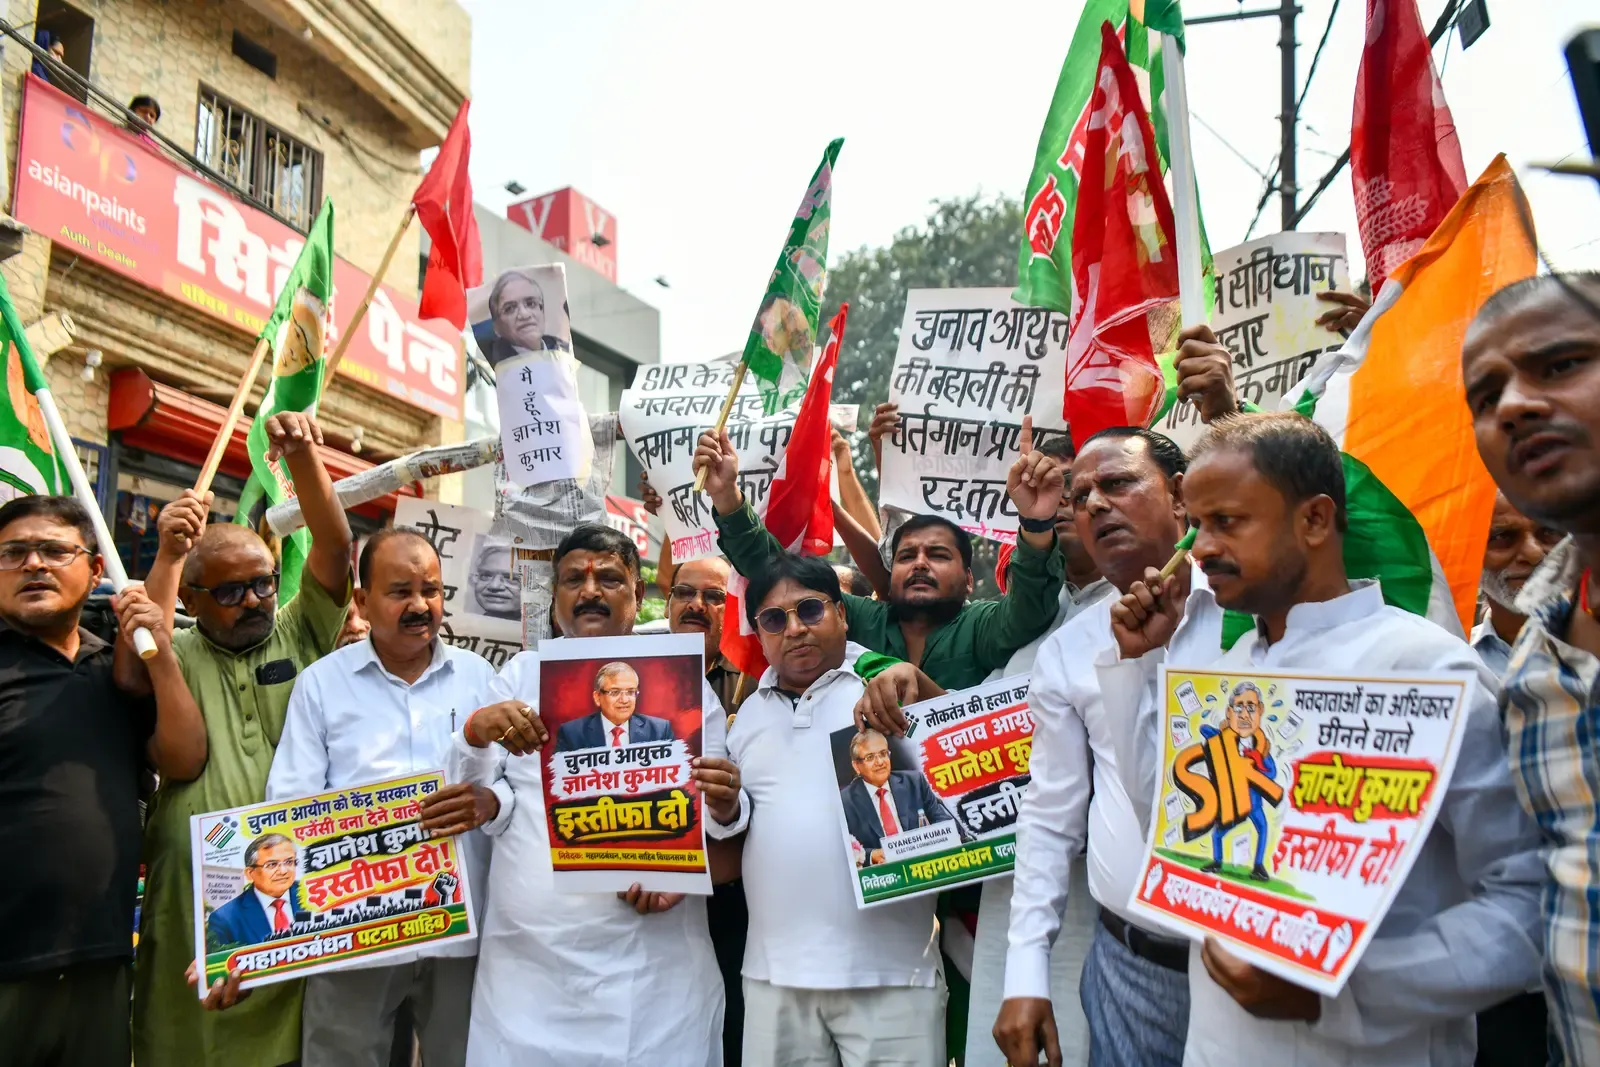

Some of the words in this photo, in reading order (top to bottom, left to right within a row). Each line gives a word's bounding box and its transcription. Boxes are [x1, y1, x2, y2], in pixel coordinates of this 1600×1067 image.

[28, 159, 147, 236] asianpaints
[60, 224, 93, 250] Auth.
[97, 240, 137, 269] Dealer
[912, 308, 993, 352] चुनाव
[641, 365, 688, 391] SIR
[894, 356, 932, 396] की
[927, 361, 1009, 411] बहाली
[1000, 363, 1042, 416] की
[512, 417, 561, 443] ज्ञानेश
[635, 425, 696, 469] तमाम
[891, 403, 986, 456] वर्तमान
[518, 446, 562, 472] कुमार
[924, 702, 966, 728] लोकतंत्र
[967, 695, 984, 715] की
[984, 691, 1012, 711] हत्या
[1294, 685, 1361, 717] मतदाताओं
[1364, 692, 1385, 716] का
[1388, 691, 1455, 722] अधिकार
[936, 721, 989, 758] चुनाव
[1317, 716, 1370, 751] छीनने
[1372, 718, 1414, 755] वाले
[563, 749, 611, 775] चुनाव
[613, 743, 673, 769] आयुक्त
[929, 744, 1004, 791] ज्ञानेश
[561, 769, 620, 796] ज्ञानेश
[622, 764, 681, 793] कुमार
[1293, 754, 1360, 810] ज्ञानेश
[1353, 766, 1436, 823] कुमार
[247, 807, 288, 835] चुनाव
[291, 799, 332, 822] आयोग
[334, 794, 349, 812] को
[350, 790, 374, 811] केंद्र
[377, 783, 419, 804] सरकार
[420, 778, 439, 796] का
[293, 815, 336, 842] एजेंसी
[367, 808, 389, 830] देने
[555, 796, 653, 841] इस्तीफा
[657, 790, 690, 830] दो
[310, 831, 379, 870] ज्ञानेश
[888, 834, 922, 850] GYANESH
[923, 826, 952, 841] KUMAR
[306, 852, 410, 908] इस्तीफा
[909, 846, 993, 880] महागठबंधन
[1162, 871, 1239, 923] महागठबंधन
[1232, 901, 1273, 940] पटना
[1272, 907, 1332, 961] साहिब
[235, 932, 353, 971] महागठबंधन
[356, 922, 400, 947] पटना
[401, 912, 445, 938] साहिब
